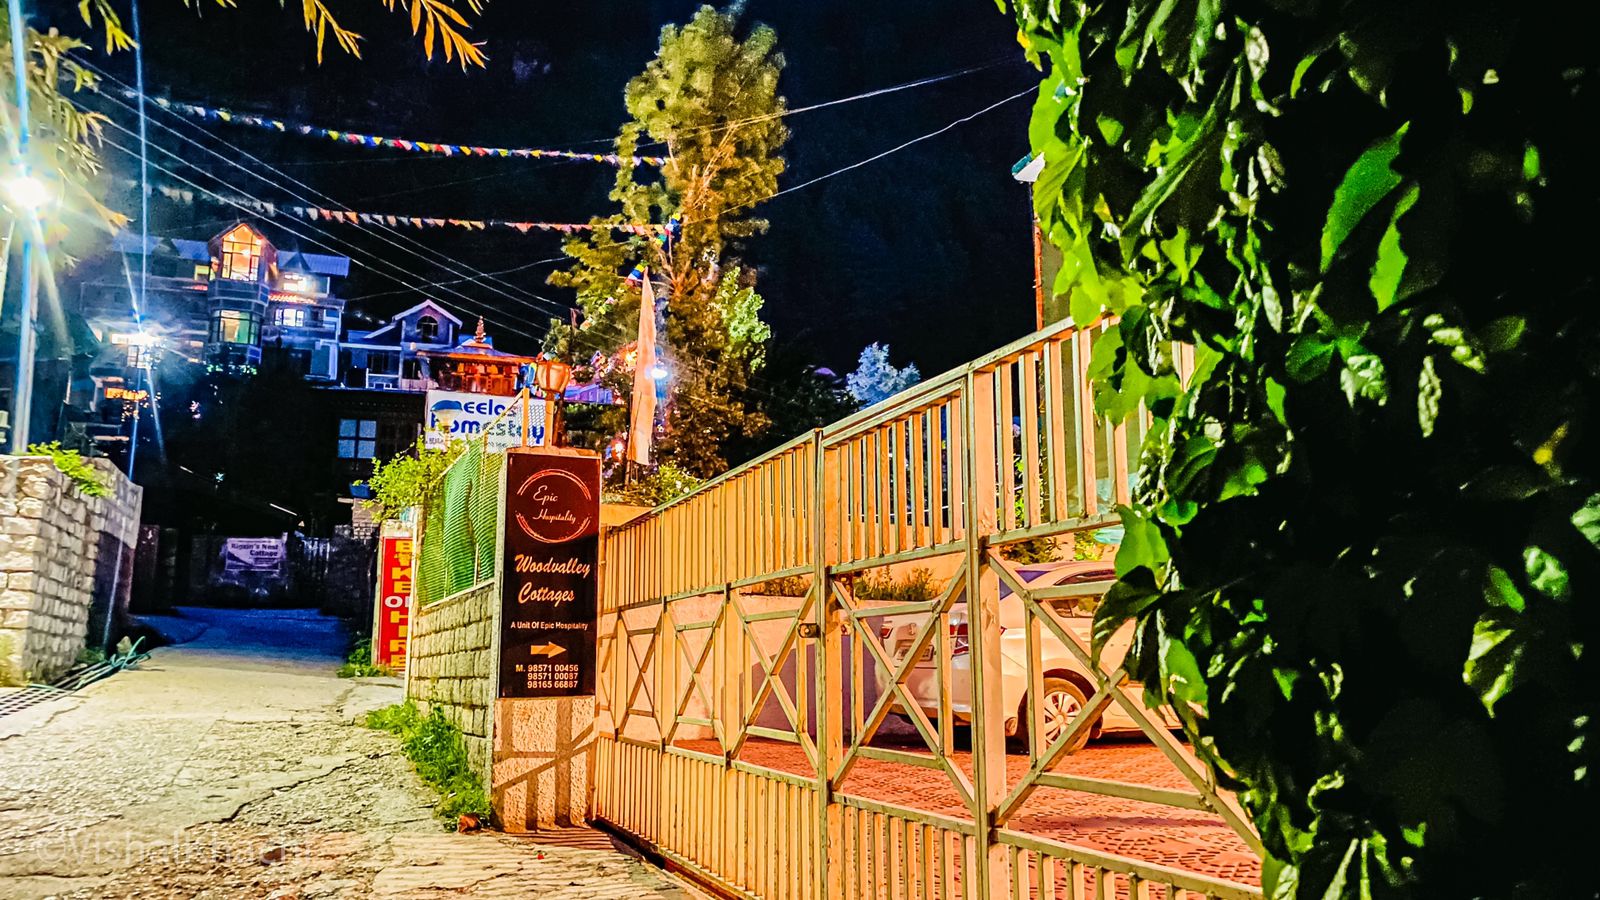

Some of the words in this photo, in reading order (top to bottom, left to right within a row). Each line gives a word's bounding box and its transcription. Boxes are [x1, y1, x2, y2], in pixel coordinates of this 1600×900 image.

[533, 485, 558, 505] Epic
[532, 508, 576, 524] Hospitality
[514, 553, 591, 579] Woodvalley
[517, 581, 575, 608] Cottages
[510, 621, 517, 629] A
[516, 621, 531, 629] Unit
[531, 621, 540, 629] Of
[540, 621, 555, 630] Epic
[555, 622, 589, 631] Hospitality
[515, 664, 526, 672] M.
[527, 664, 552, 672] 98571
[554, 664, 579, 672] 00456
[527, 672, 552, 680] 98571
[554, 672, 579, 680] 00087
[527, 681, 553, 689] 98165
[554, 680, 579, 689] 66887
